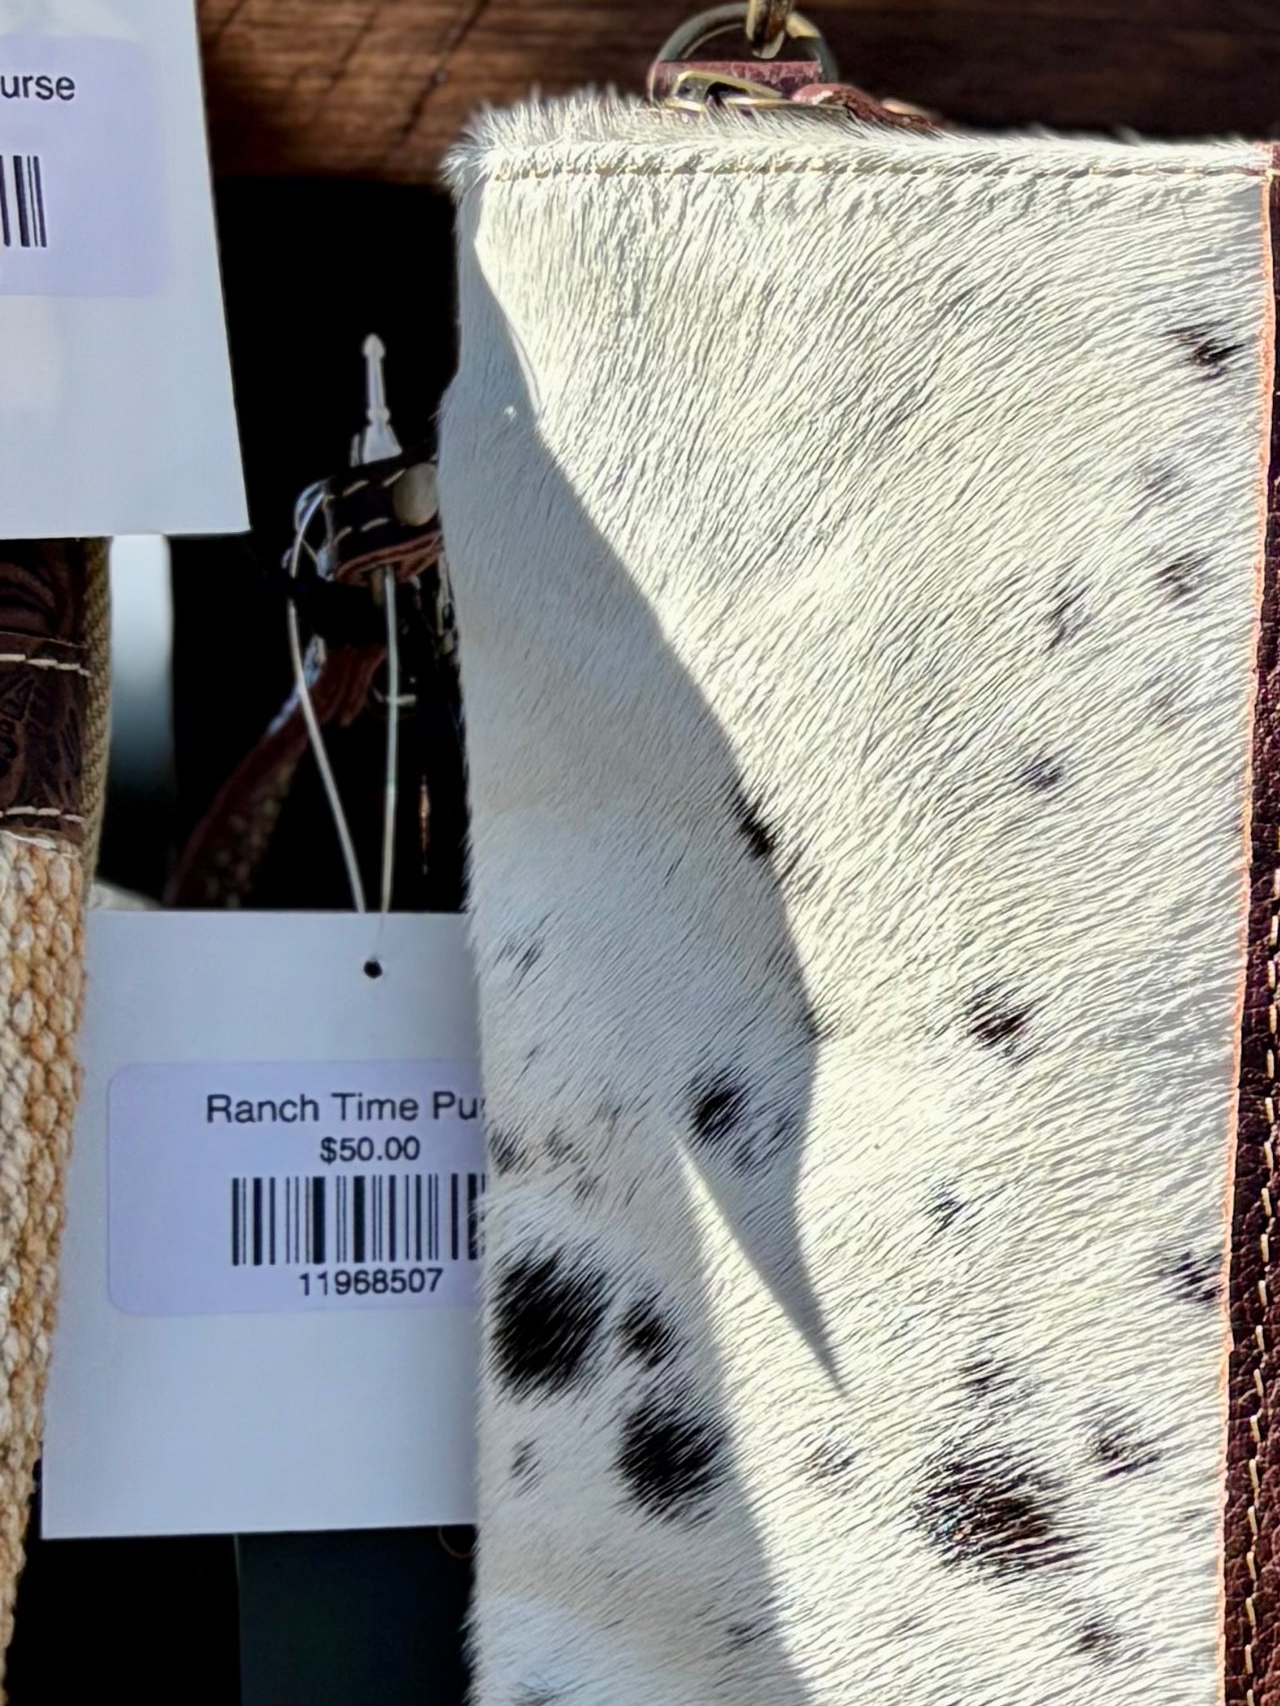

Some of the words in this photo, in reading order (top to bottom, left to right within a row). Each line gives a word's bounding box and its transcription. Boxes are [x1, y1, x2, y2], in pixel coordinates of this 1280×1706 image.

[0, 76, 75, 100] urse
[206, 1093, 320, 1124] Ranch
[331, 1092, 420, 1122] Time
[319, 1135, 421, 1165] $50.00
[299, 1267, 444, 1296] 11968507
